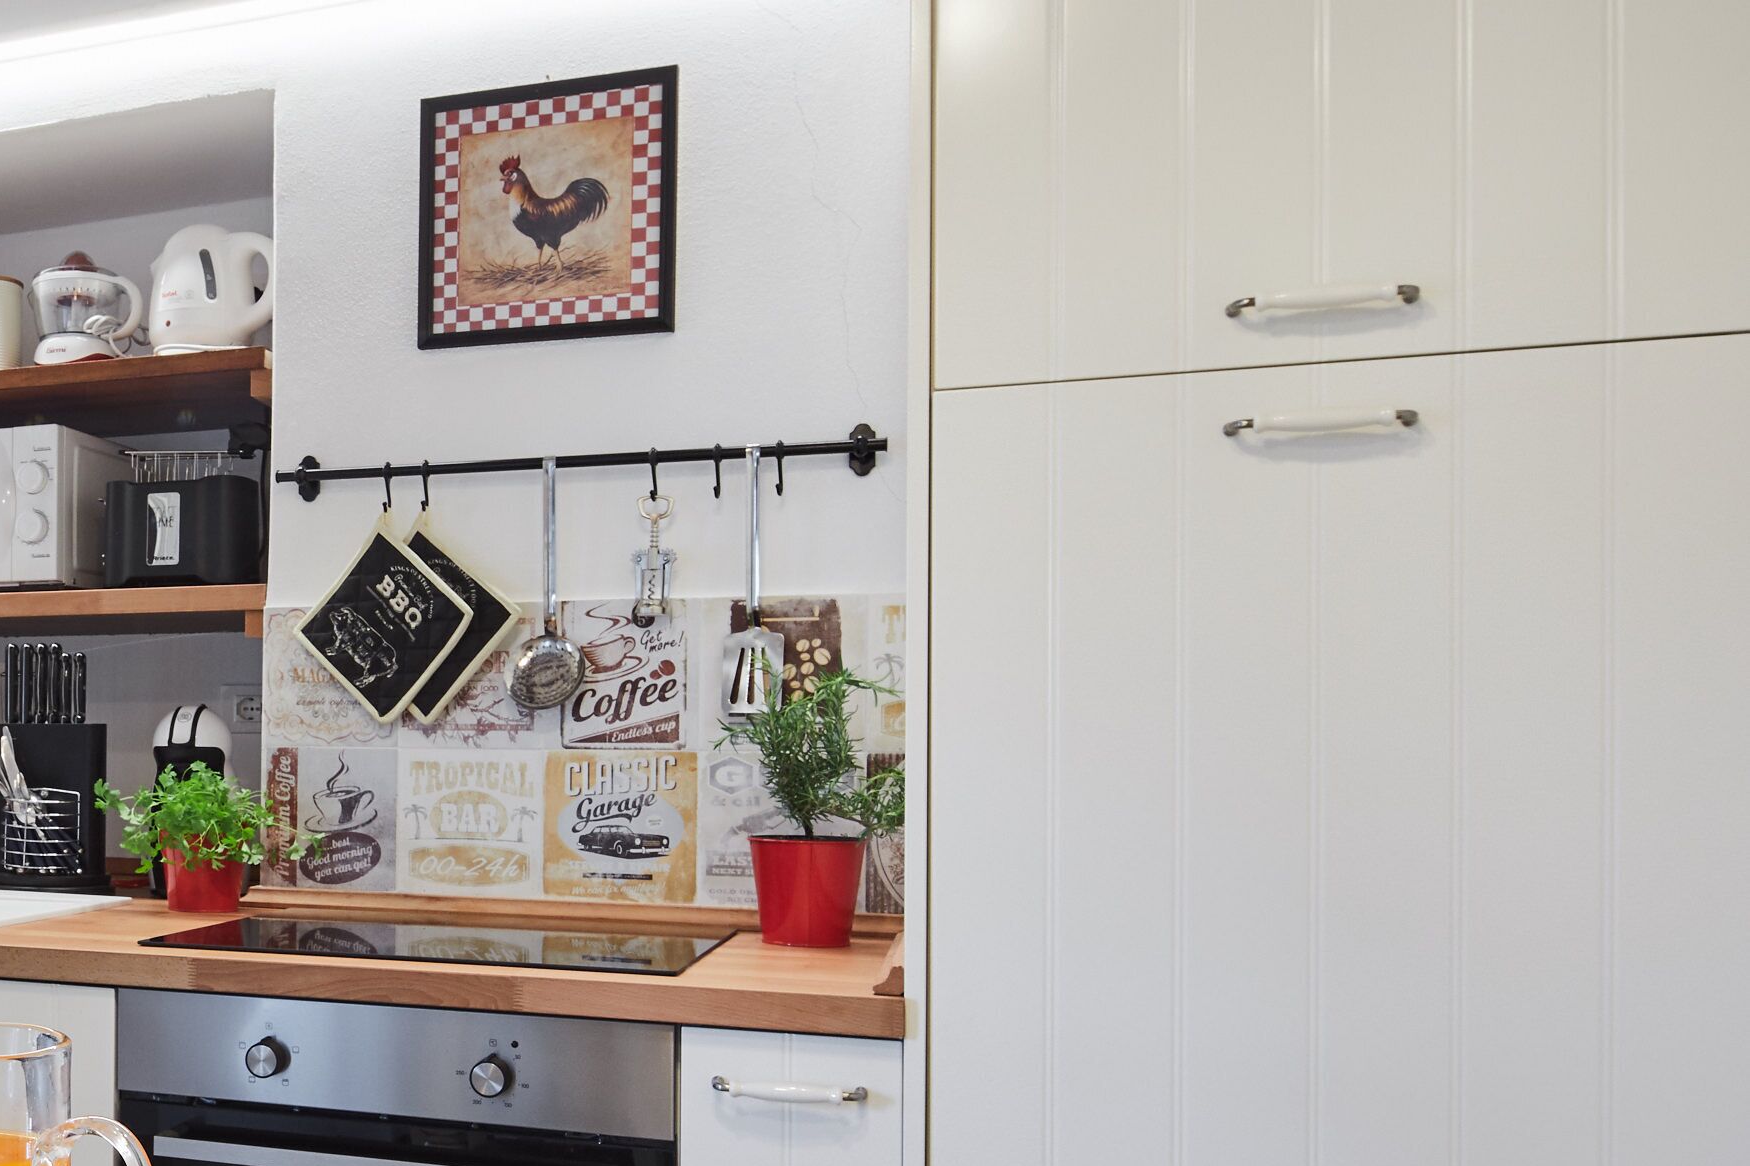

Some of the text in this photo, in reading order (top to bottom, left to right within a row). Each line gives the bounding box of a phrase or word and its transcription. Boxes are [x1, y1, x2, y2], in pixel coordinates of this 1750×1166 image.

[375, 574, 423, 630] BBQ
[640, 629, 662, 651] Get
[649, 630, 685, 654] more!
[571, 676, 680, 725] Coffee
[611, 719, 677, 743] Endless cup
[410, 760, 536, 799] TROPICAL
[564, 755, 678, 797] CLASSIC
[273, 755, 296, 877] Premium Coffee
[439, 802, 500, 833] BAR
[571, 793, 657, 833] Garage
[314, 856, 372, 881] you can get!
[419, 854, 522, 879] 00-24h
[712, 867, 746, 875] NEXT
